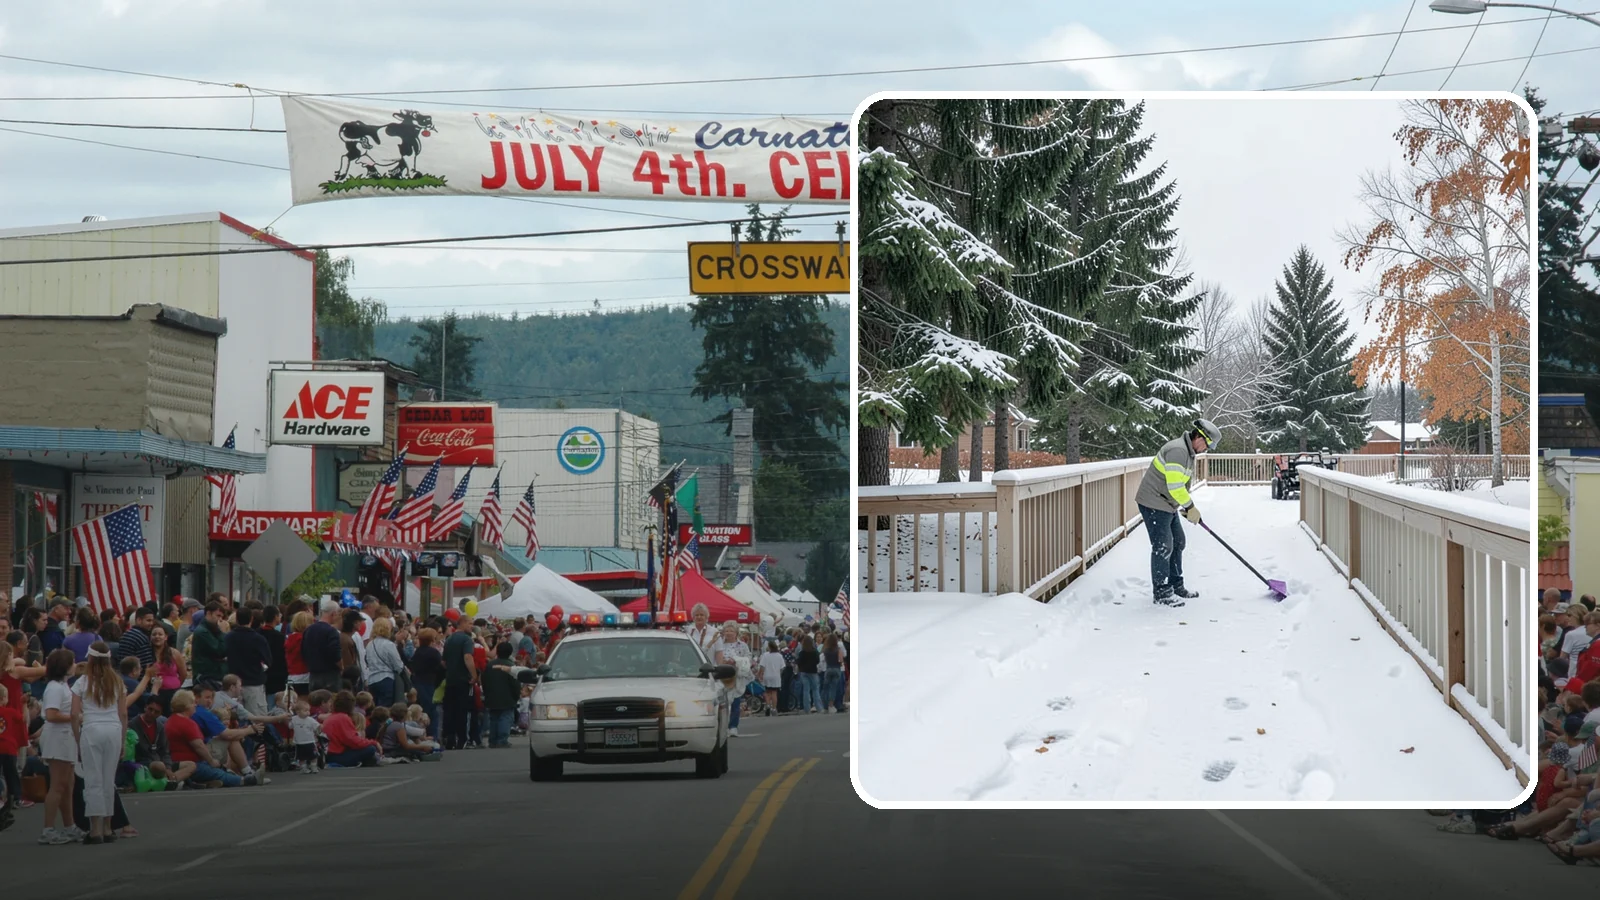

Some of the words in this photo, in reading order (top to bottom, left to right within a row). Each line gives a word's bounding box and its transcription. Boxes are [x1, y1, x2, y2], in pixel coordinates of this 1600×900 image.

[481, 141, 605, 193] JULY
[632, 150, 746, 198] 4th.
[697, 254, 850, 280] CROSSWA
[283, 380, 373, 420] ACE
[406, 409, 452, 422] CEDAR
[284, 421, 370, 436] Hardware
[416, 428, 477, 446] Coca-Cola
[353, 467, 386, 480] Simpl
[83, 485, 93, 494] St.
[96, 485, 124, 495] Vincent
[126, 486, 136, 495] de
[138, 486, 155, 495] Paul
[688, 527, 742, 535] CRNATION
[699, 535, 730, 543] GLASS
